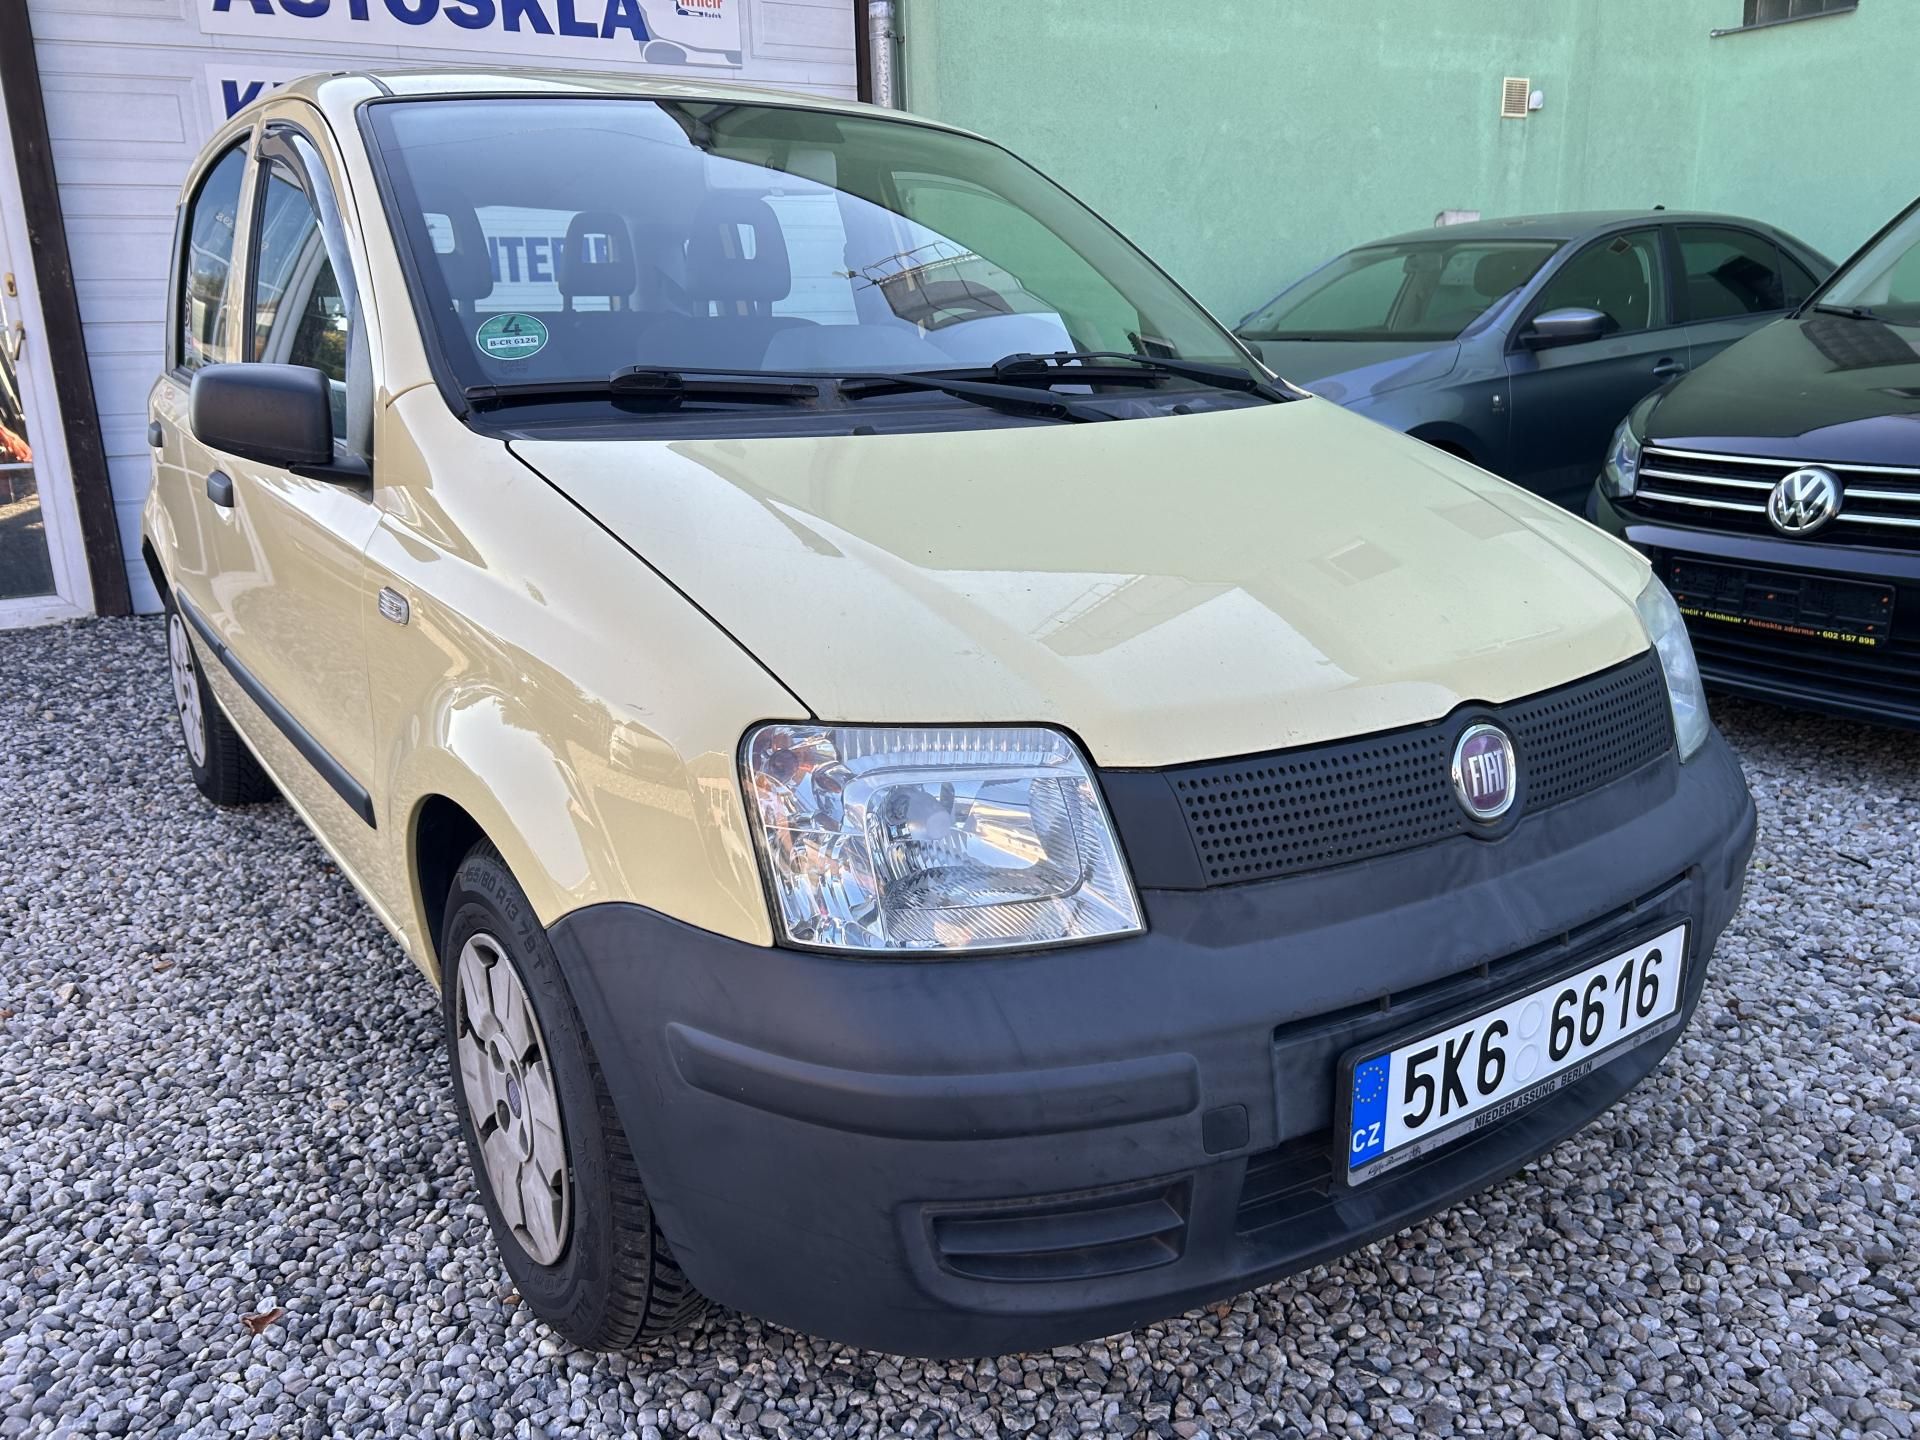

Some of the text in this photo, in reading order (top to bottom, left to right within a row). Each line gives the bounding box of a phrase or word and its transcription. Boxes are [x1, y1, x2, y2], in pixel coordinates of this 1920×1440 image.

[490, 339, 512, 347] B-CR
[502, 316, 522, 336] 4
[1704, 611, 1741, 624] Autobazar
[1822, 630, 1839, 640] 602
[1841, 633, 1857, 642] 157
[1859, 636, 1875, 645] 898
[1468, 749, 1504, 798] FIAT
[1403, 947, 1663, 1129] 5K6 6616
[1474, 1060, 1593, 1129] NIEDERLASSUNG BERLIN
[1352, 1122, 1381, 1153] CZ
